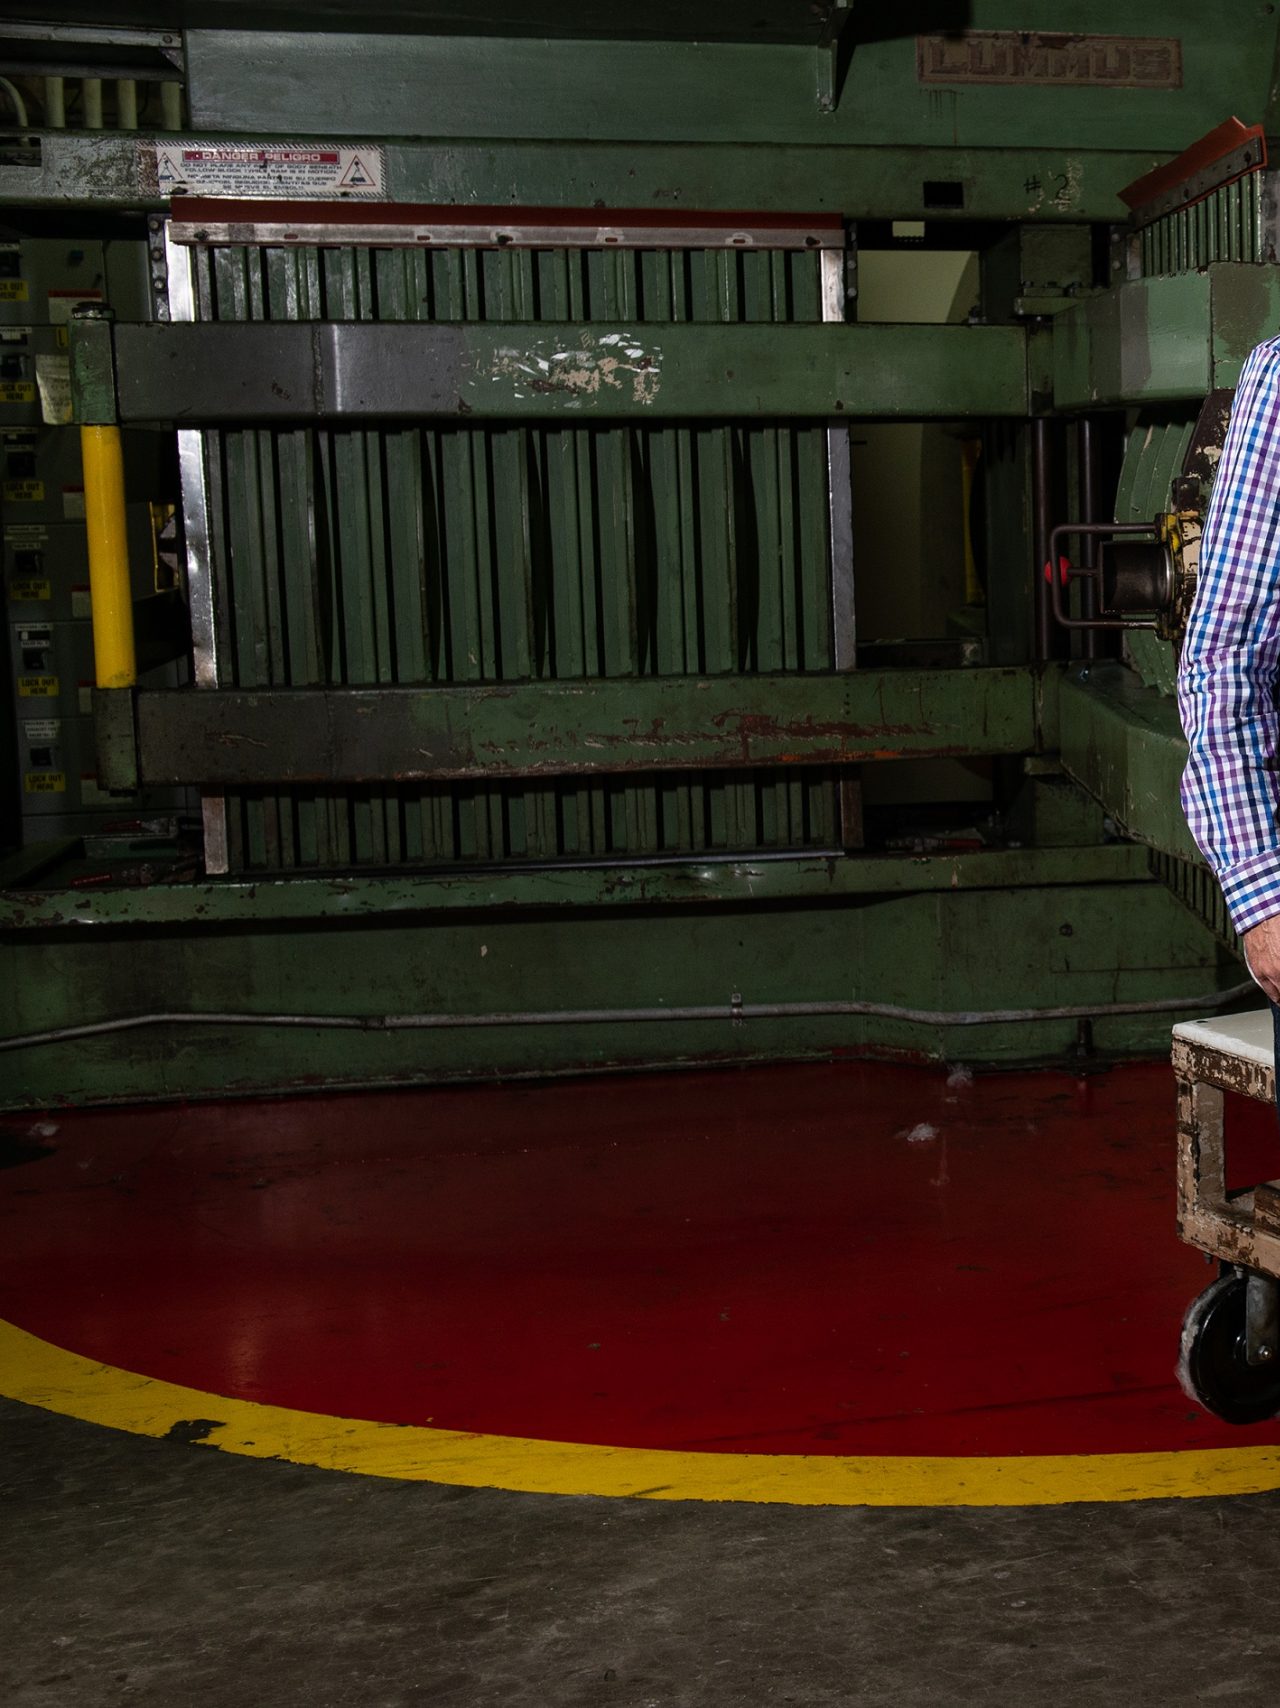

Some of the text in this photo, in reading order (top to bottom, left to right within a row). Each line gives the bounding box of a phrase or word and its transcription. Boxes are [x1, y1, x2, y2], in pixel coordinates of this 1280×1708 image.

[928, 38, 1172, 81] LUMMUS
[202, 152, 320, 161] DANGER PELIGRO
